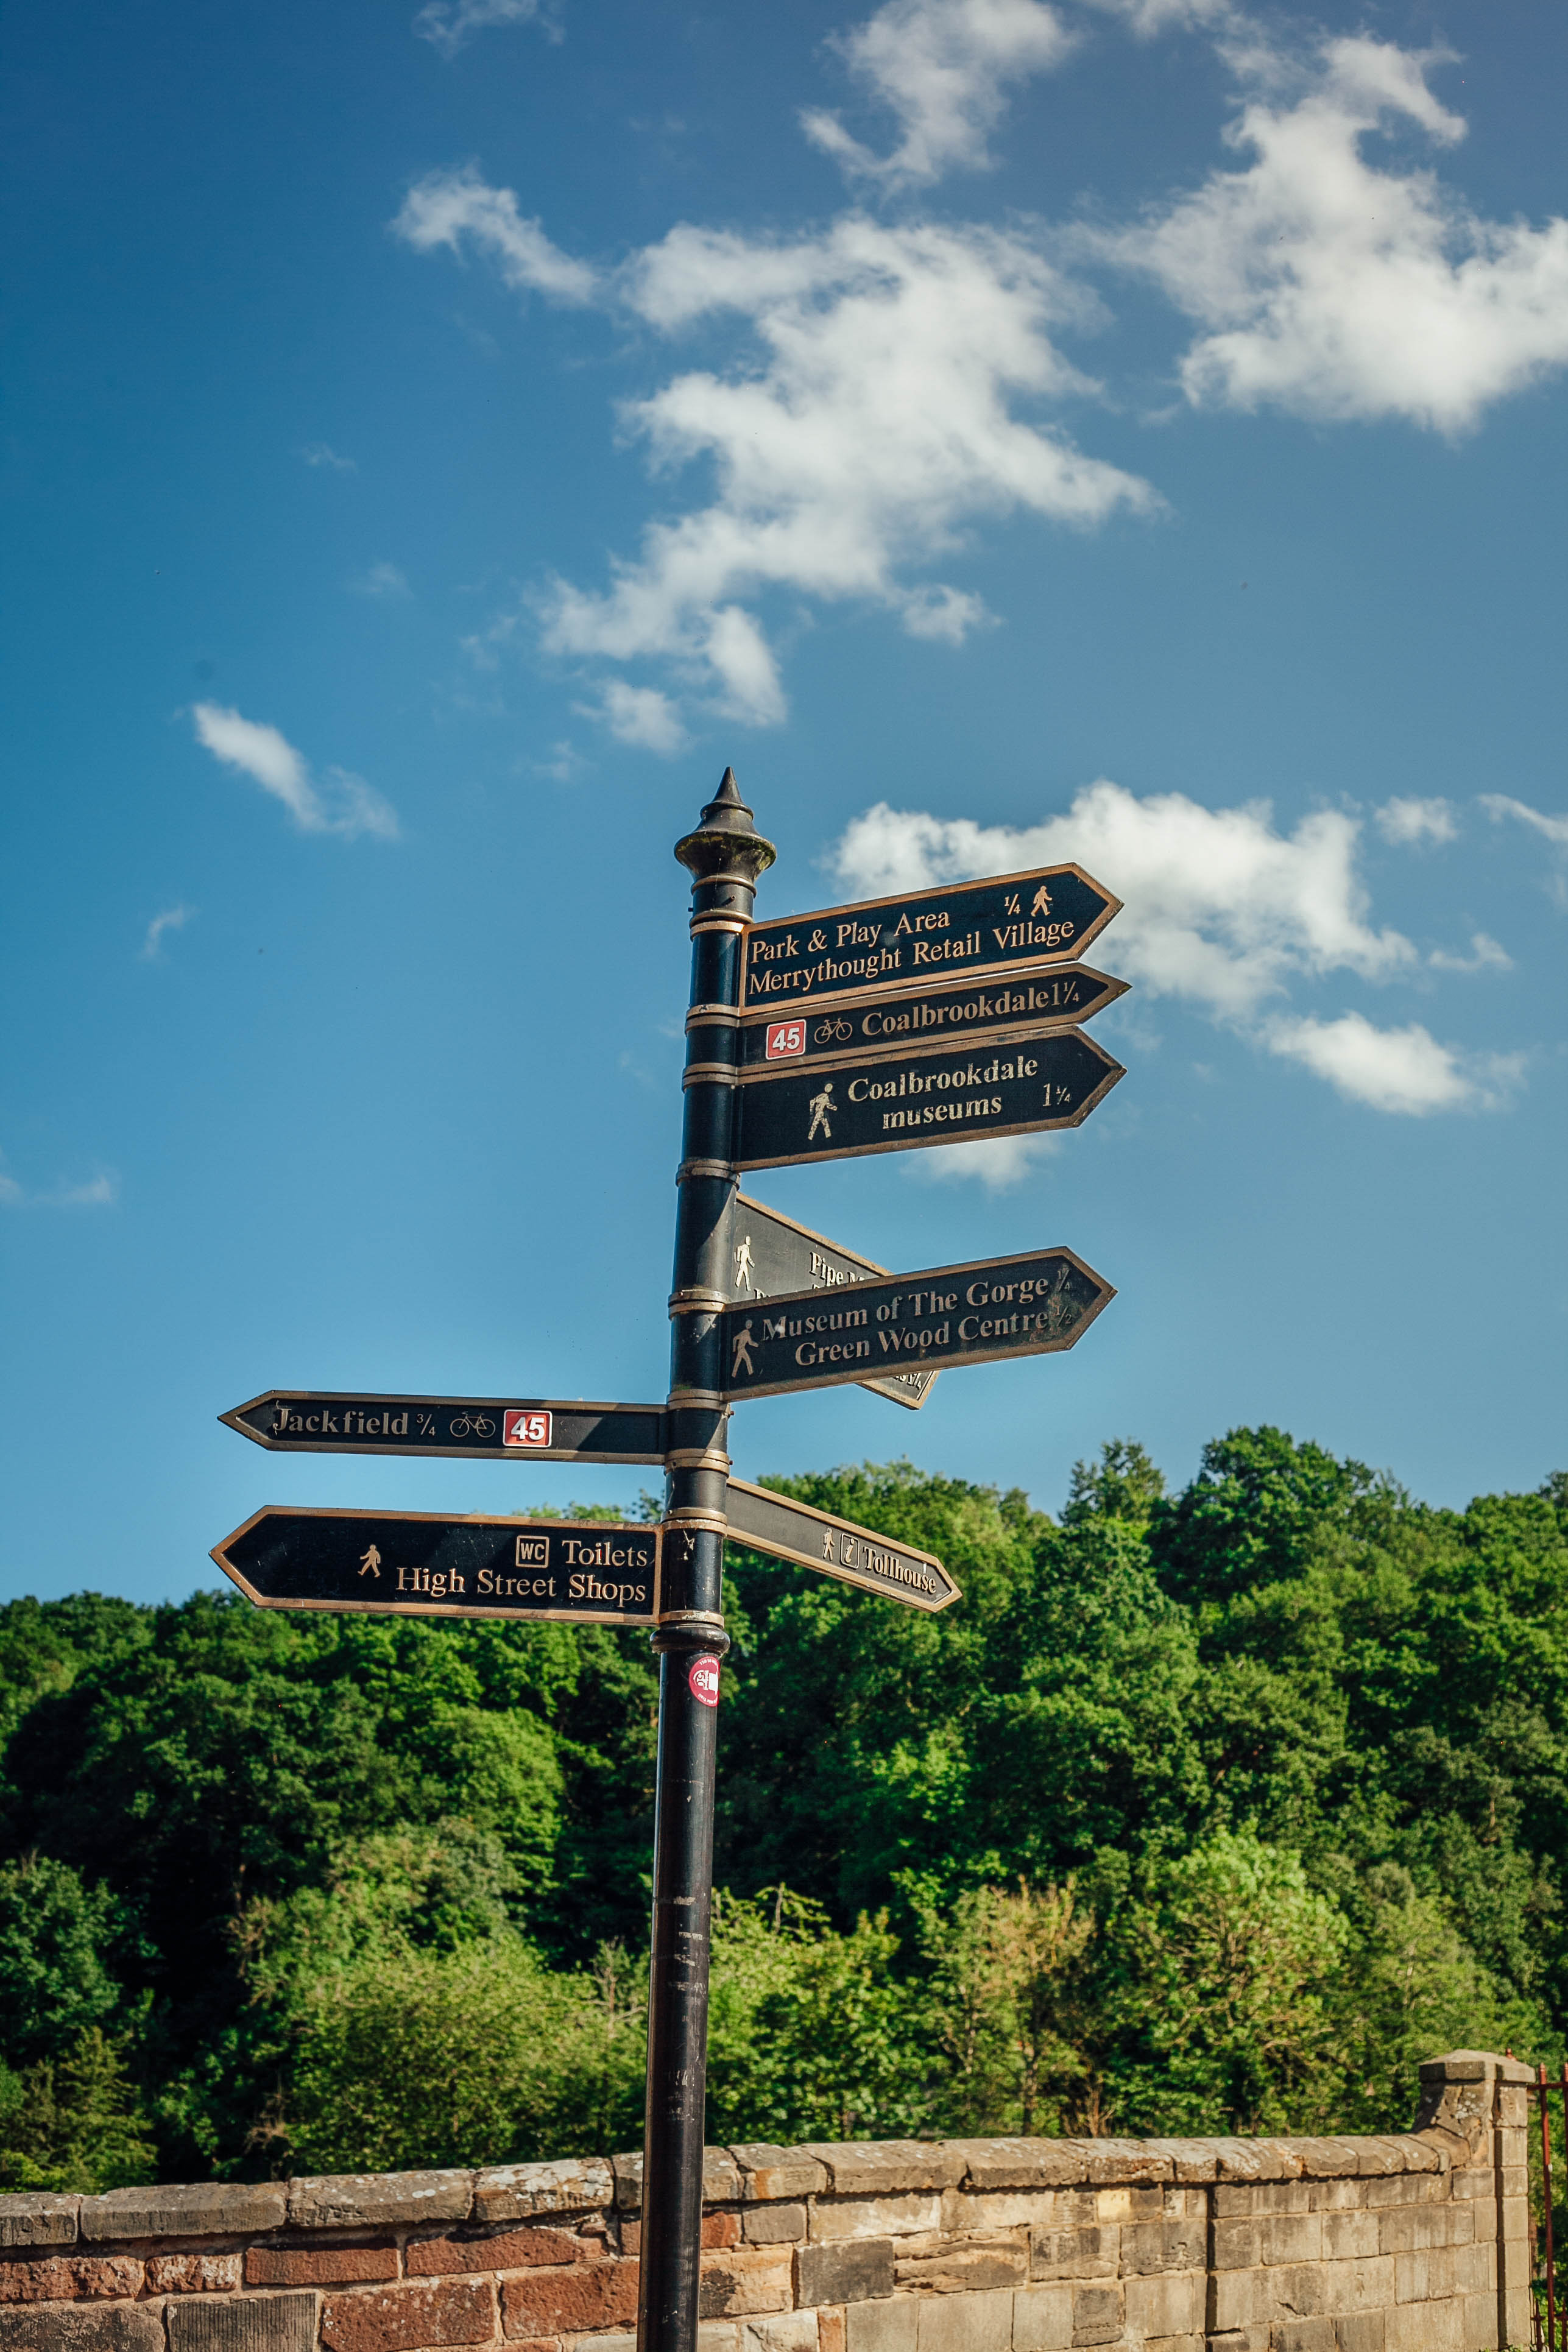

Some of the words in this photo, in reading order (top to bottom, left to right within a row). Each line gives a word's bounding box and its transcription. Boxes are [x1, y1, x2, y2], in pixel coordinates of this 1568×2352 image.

[749, 947, 902, 995] Merrythought
[913, 932, 981, 964] Retail
[993, 920, 1075, 950] Village
[750, 937, 799, 964] Park
[807, 929, 828, 952] &
[836, 921, 882, 949] Play
[894, 911, 950, 937] Area
[772, 1026, 800, 1053] 45
[861, 986, 1048, 1036] Coalbrookdale
[848, 1056, 1039, 1103] Coalbrookdale
[882, 1096, 1003, 1129] museums
[810, 1251, 844, 1287] Pipe
[761, 1308, 867, 1341] Museum
[876, 1296, 903, 1322] of
[909, 1289, 958, 1317] The
[966, 1278, 1048, 1307] Gorge
[795, 1340, 870, 1368] Green
[878, 1322, 949, 1352] Wood
[958, 1311, 1048, 1340] Centre
[272, 1408, 409, 1436] Jackfield
[510, 1416, 545, 1441] 45
[520, 1543, 546, 1561] WC
[562, 1539, 648, 1567] Toilets
[863, 1546, 937, 1595] Tollhouse
[397, 1567, 466, 1596] High
[477, 1569, 557, 1597] Street
[569, 1573, 646, 1608] Shops
